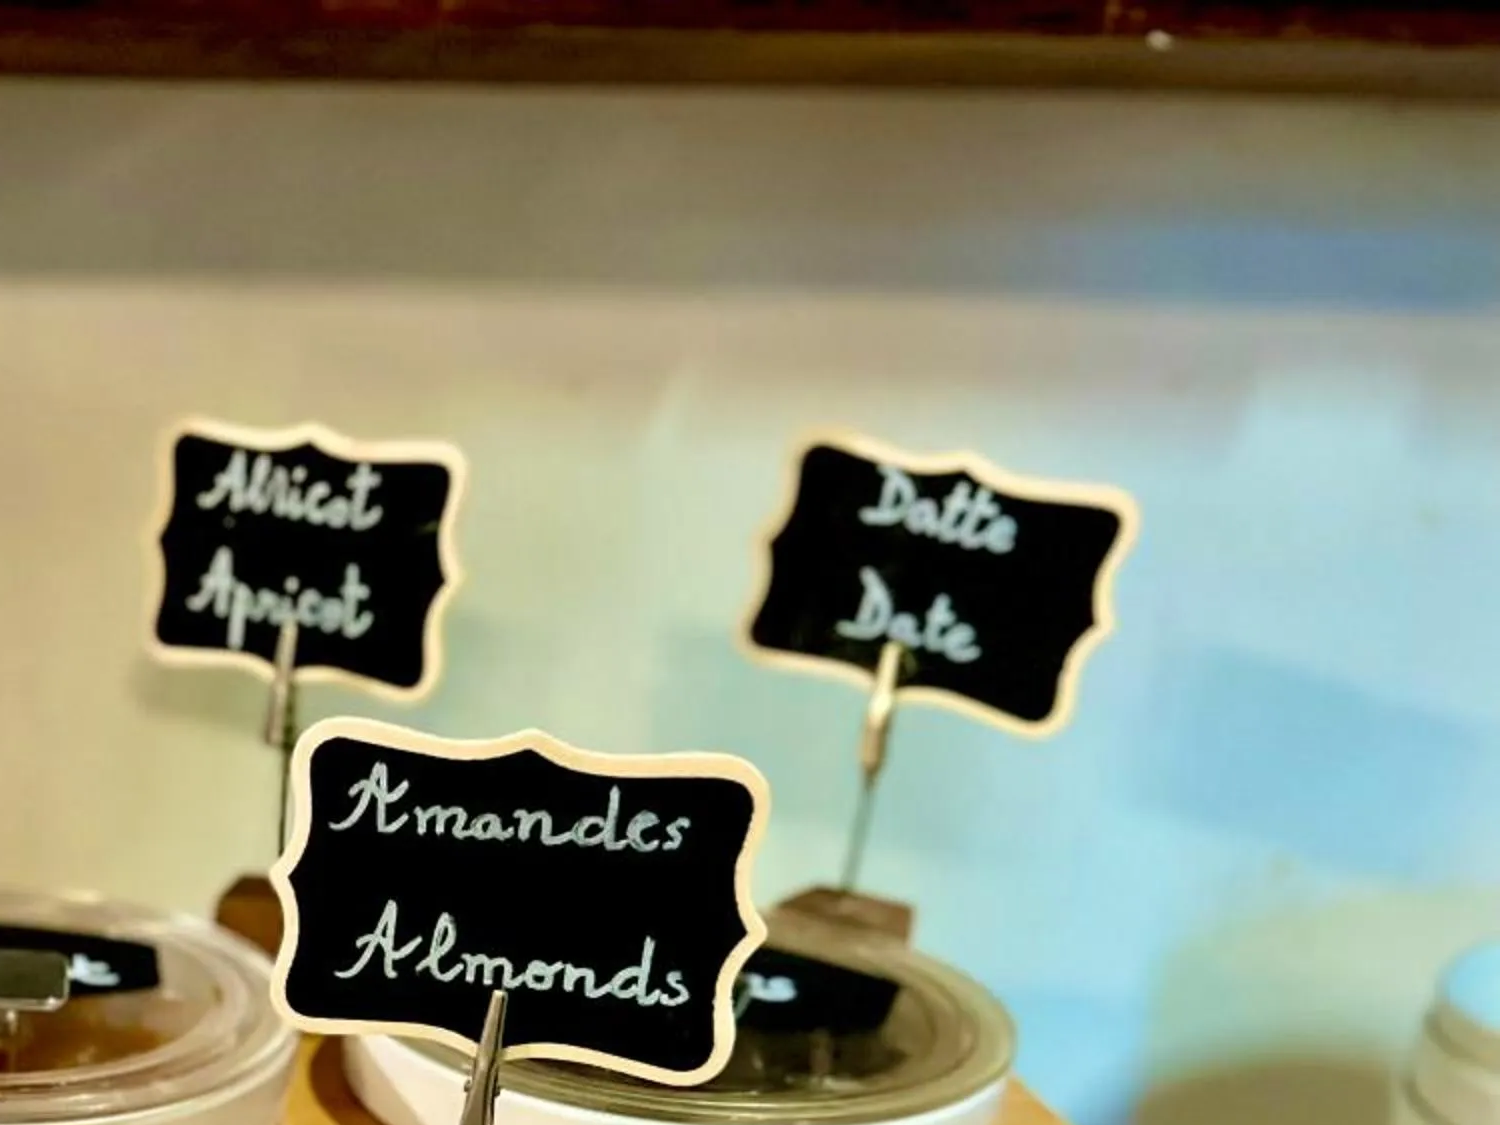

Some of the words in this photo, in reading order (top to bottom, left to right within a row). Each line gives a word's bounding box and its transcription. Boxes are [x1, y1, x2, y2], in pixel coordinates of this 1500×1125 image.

[196, 448, 384, 532] Abricot
[858, 463, 1018, 555] Datte
[184, 545, 375, 650] Apricot
[834, 565, 982, 663] Date
[328, 760, 692, 853] Amandes
[333, 899, 691, 1007] Almonds
